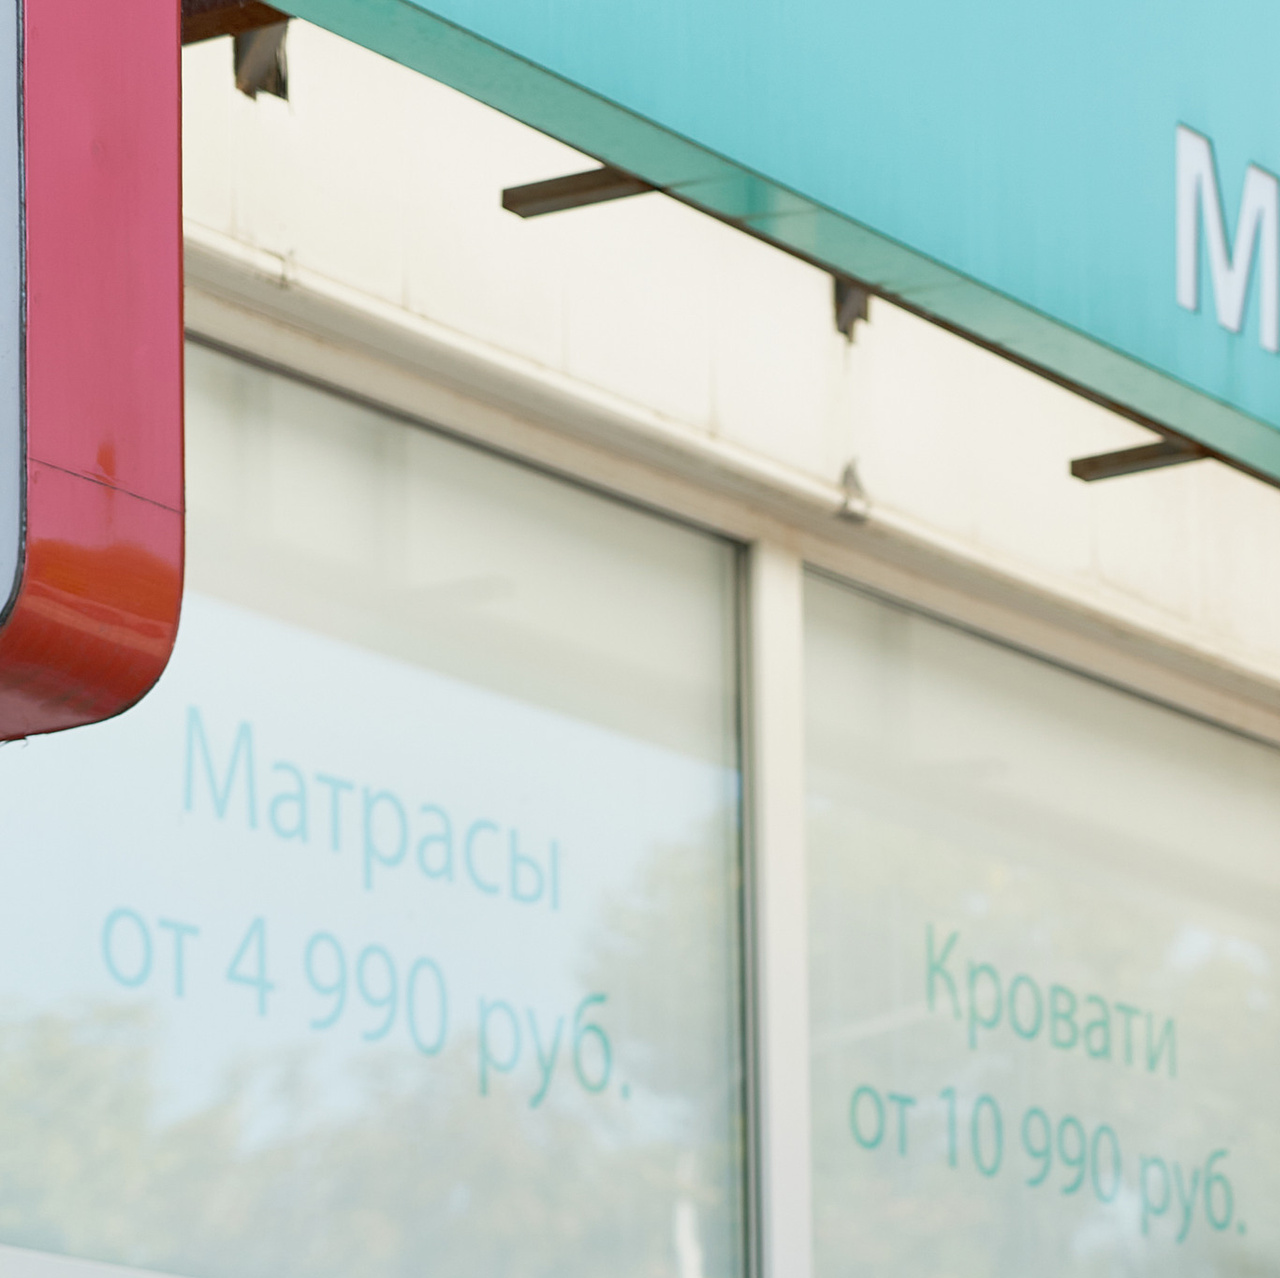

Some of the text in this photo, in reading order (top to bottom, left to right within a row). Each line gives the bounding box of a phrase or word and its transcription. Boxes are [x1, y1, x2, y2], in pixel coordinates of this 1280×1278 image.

[183, 706, 561, 911] Матрасы
[101, 907, 631, 1109] от 4 990 руб.
[926, 922, 1177, 1079] Кровати
[850, 1086, 1246, 1245] от 10 990 руб.
